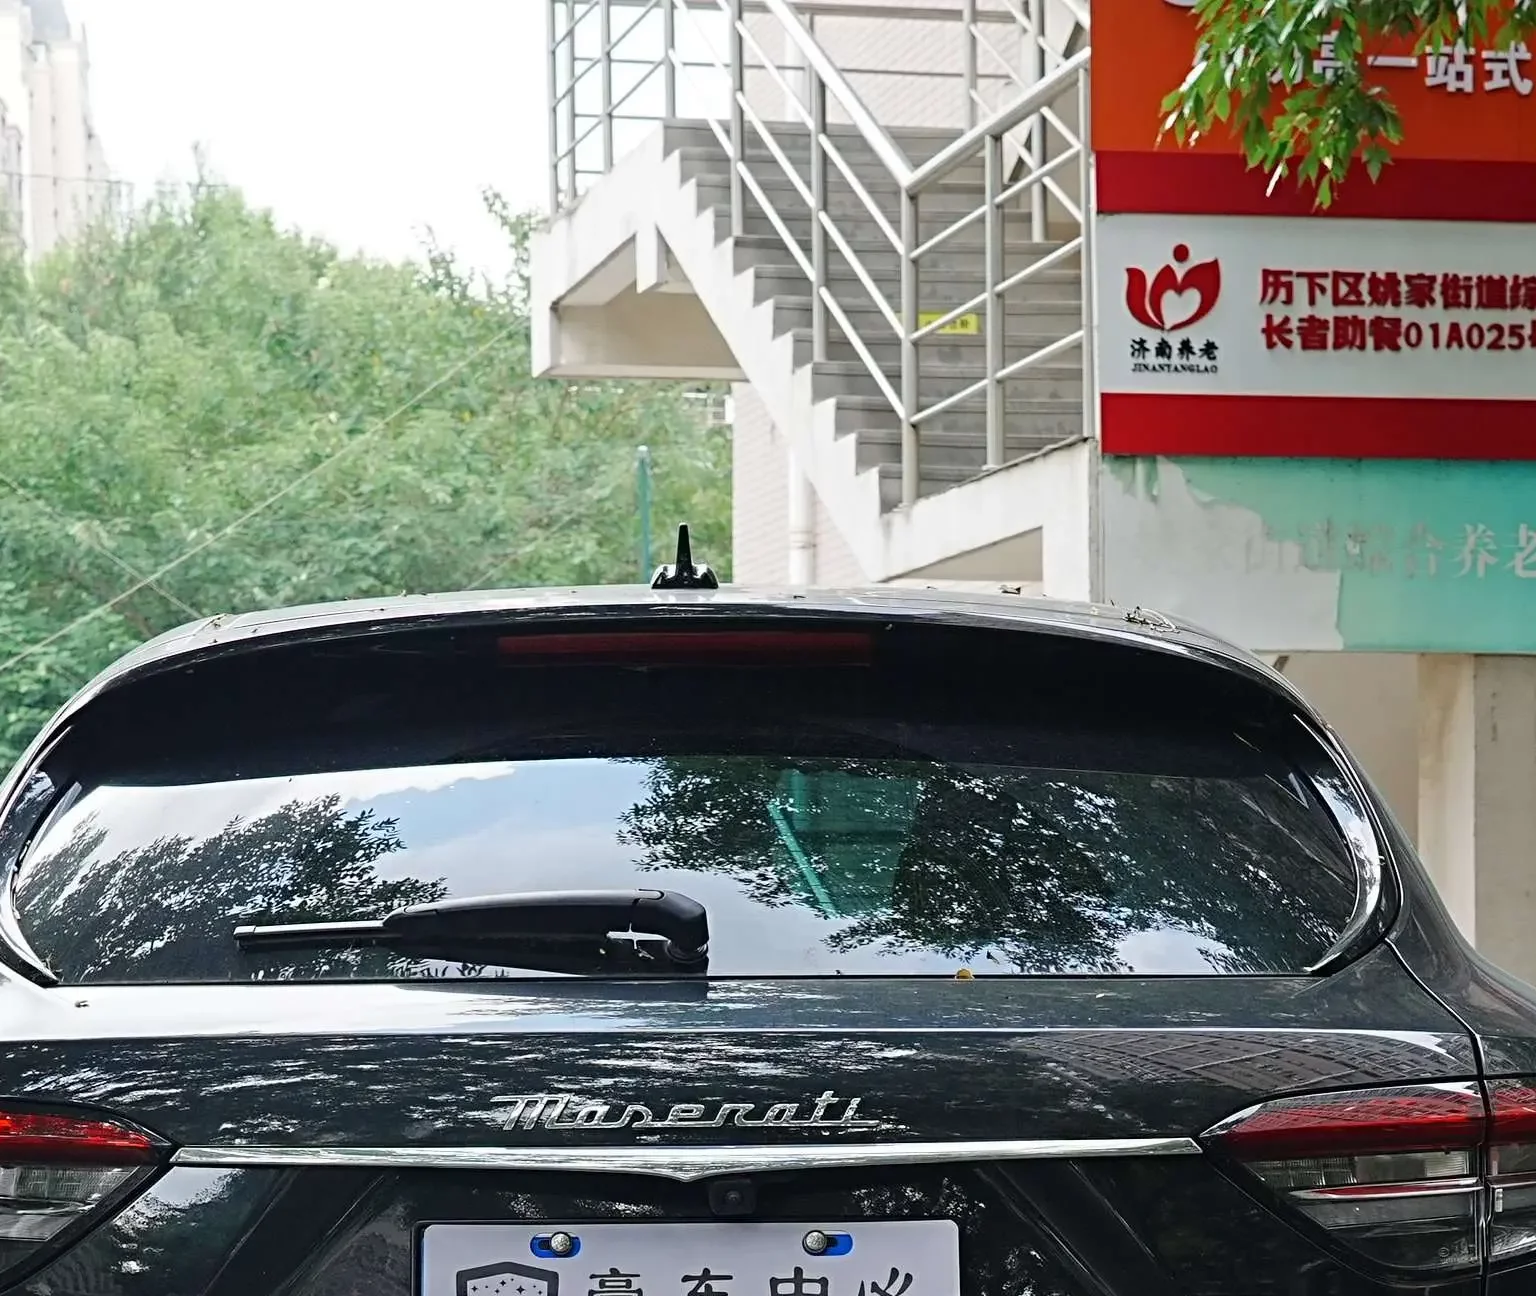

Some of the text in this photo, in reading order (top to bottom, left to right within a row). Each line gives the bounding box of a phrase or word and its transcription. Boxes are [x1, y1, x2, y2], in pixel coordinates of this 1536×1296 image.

[1130, 337, 1219, 361] 济南养老
[490, 1091, 880, 1131] Maserati
